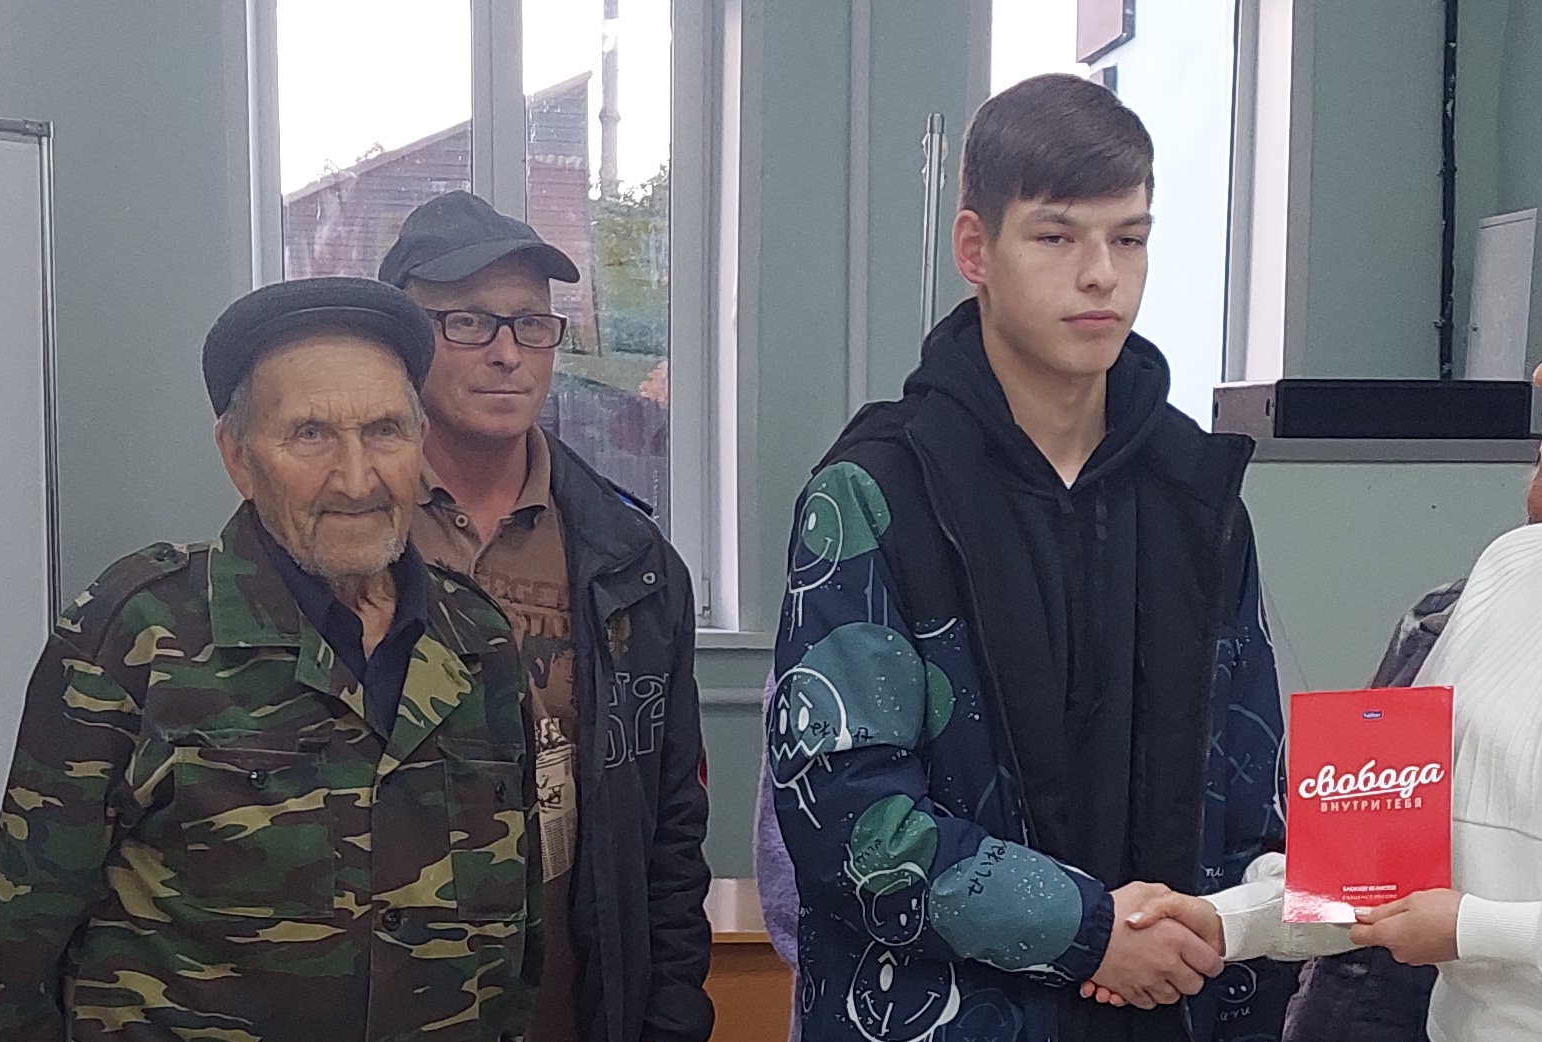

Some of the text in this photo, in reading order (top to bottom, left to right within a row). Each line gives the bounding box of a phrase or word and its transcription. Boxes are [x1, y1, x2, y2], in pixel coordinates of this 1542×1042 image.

[1298, 759, 1445, 799] свобода
[1320, 797, 1422, 813] ВНУТРИ ТЕБЯ
